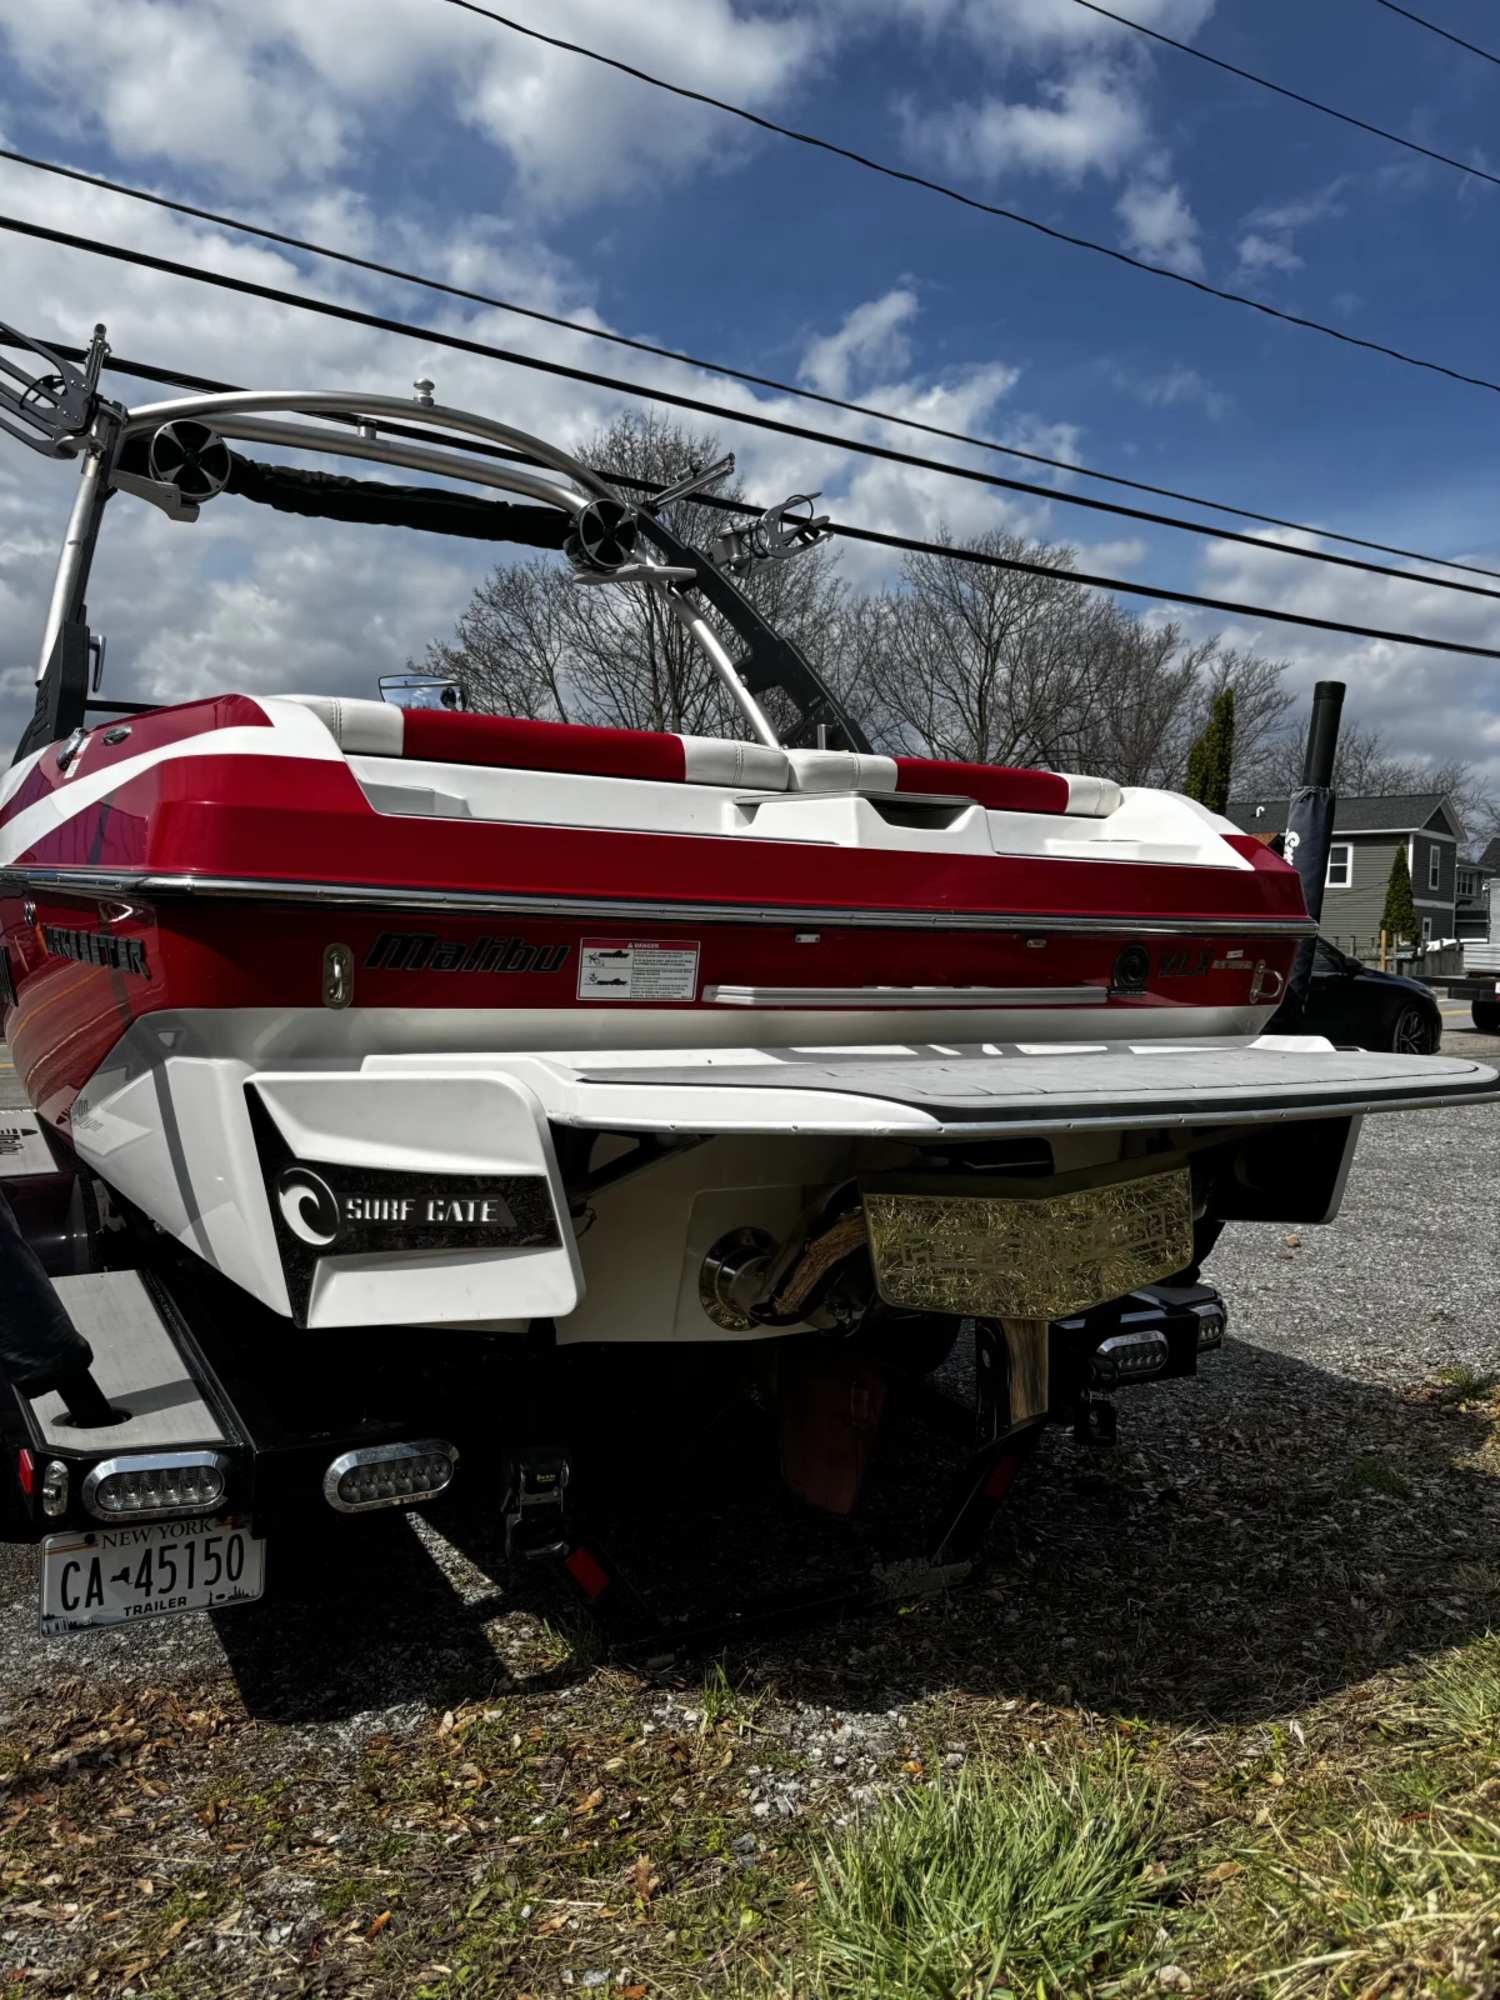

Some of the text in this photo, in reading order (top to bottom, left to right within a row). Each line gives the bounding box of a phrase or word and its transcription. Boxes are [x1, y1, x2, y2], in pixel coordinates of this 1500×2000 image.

[361, 930, 572, 974] Malibu
[634, 942, 660, 950] DANGER
[1157, 948, 1216, 978] VLX
[345, 1197, 499, 1222] SURF GATE
[101, 1517, 213, 1549] NEW YORK
[60, 1533, 245, 1612] CA 45150
[123, 1596, 187, 1617] TRAILER
